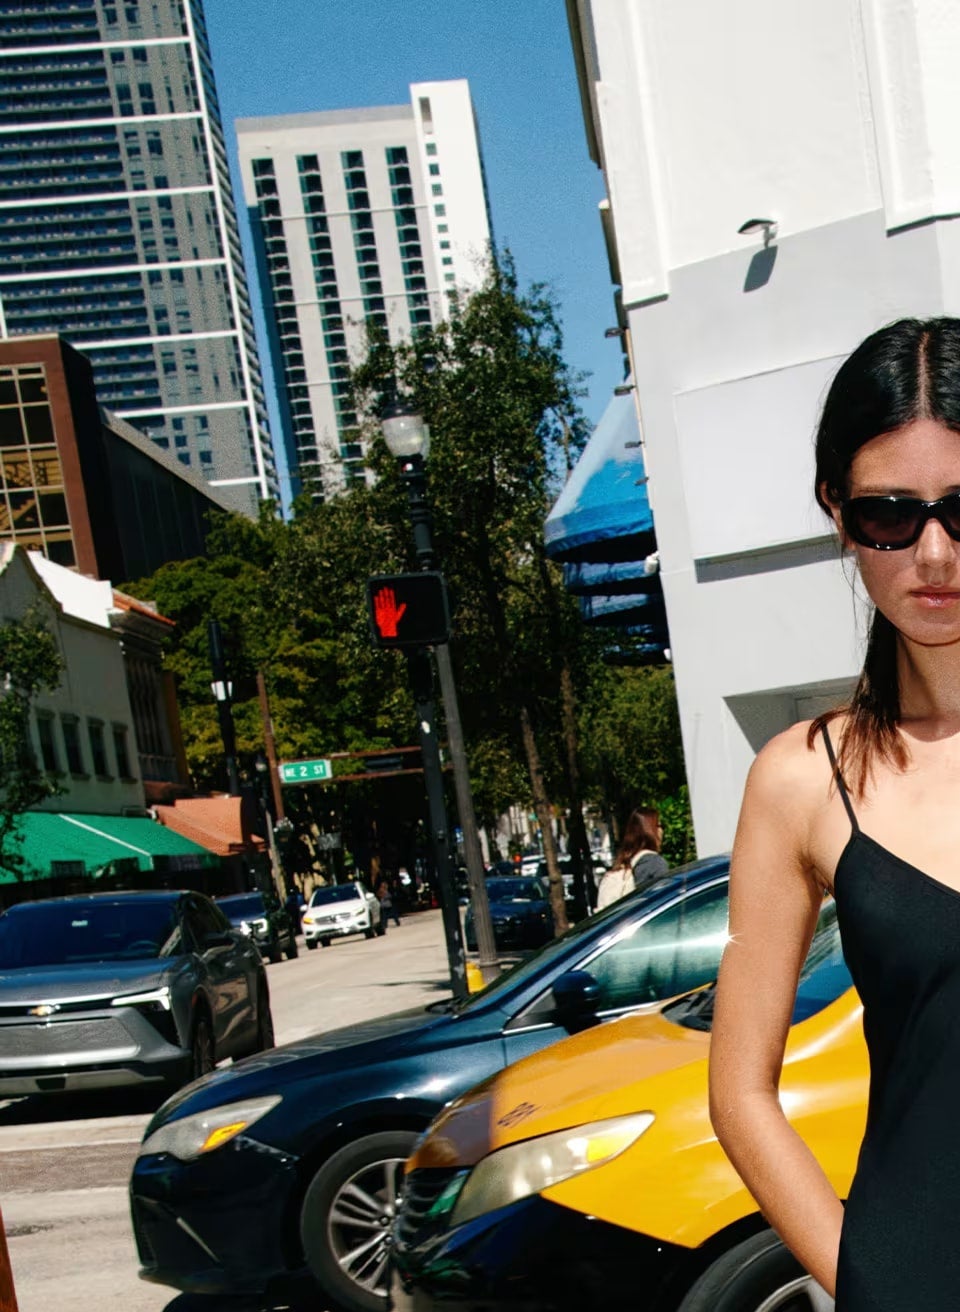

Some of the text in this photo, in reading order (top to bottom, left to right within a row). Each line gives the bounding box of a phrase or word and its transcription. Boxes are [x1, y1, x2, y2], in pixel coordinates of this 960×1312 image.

[285, 764, 324, 777] NE 2 ST
